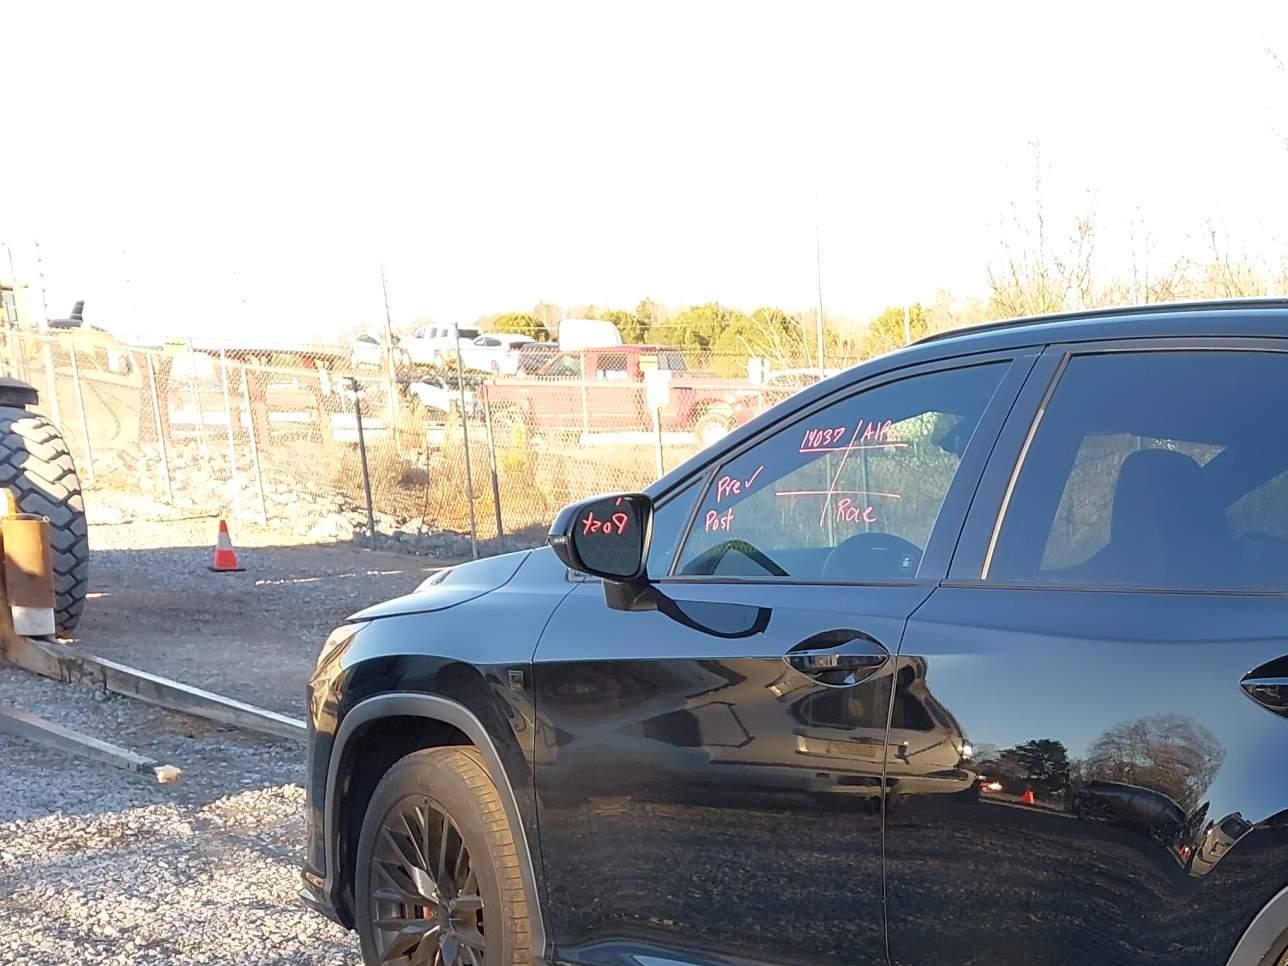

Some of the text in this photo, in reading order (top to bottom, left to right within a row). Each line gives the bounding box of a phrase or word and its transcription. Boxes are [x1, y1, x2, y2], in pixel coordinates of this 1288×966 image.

[801, 427, 846, 449] 14037
[717, 476, 741, 503] Pre
[705, 508, 734, 532] Post
